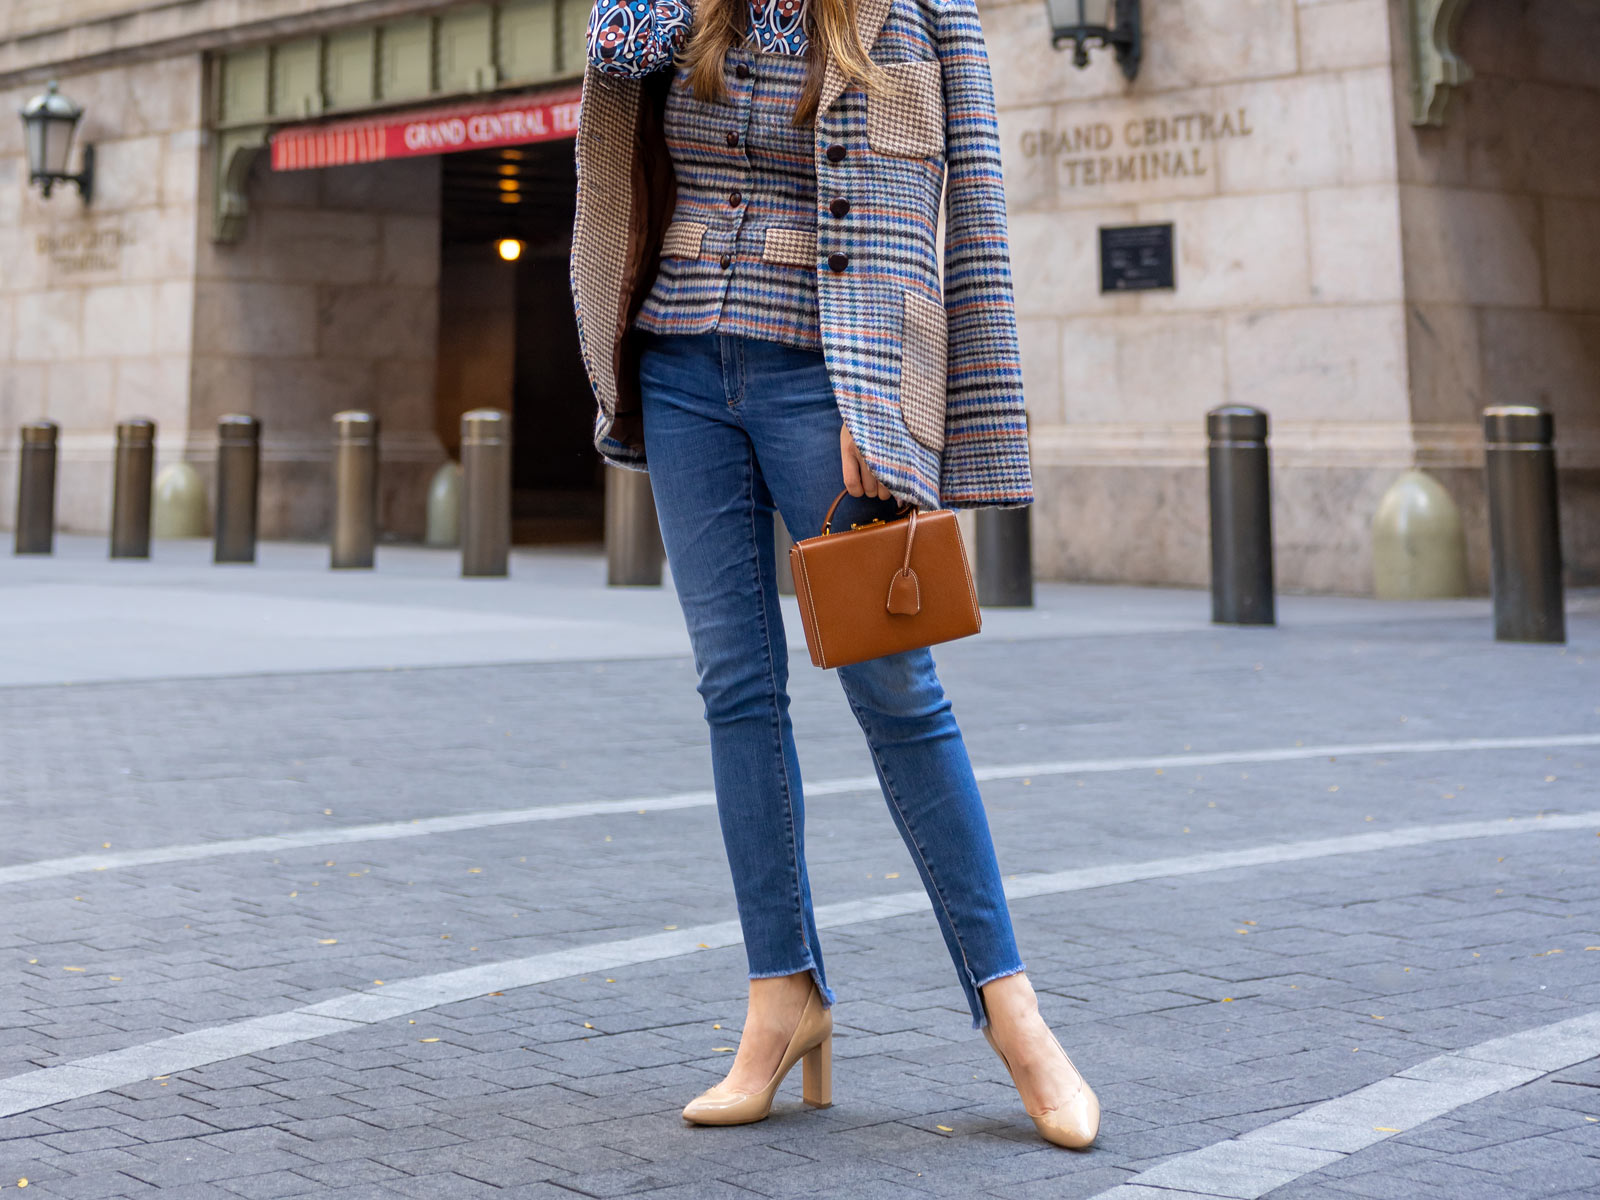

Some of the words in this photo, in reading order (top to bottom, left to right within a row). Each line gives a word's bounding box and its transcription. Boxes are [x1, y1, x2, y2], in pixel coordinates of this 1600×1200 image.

[404, 118, 466, 150] GRAND
[467, 109, 548, 143] CENTRAL
[1020, 122, 1113, 158] GRAND
[1123, 107, 1253, 148] CENTRAL
[1063, 150, 1207, 187] TERMINAL
